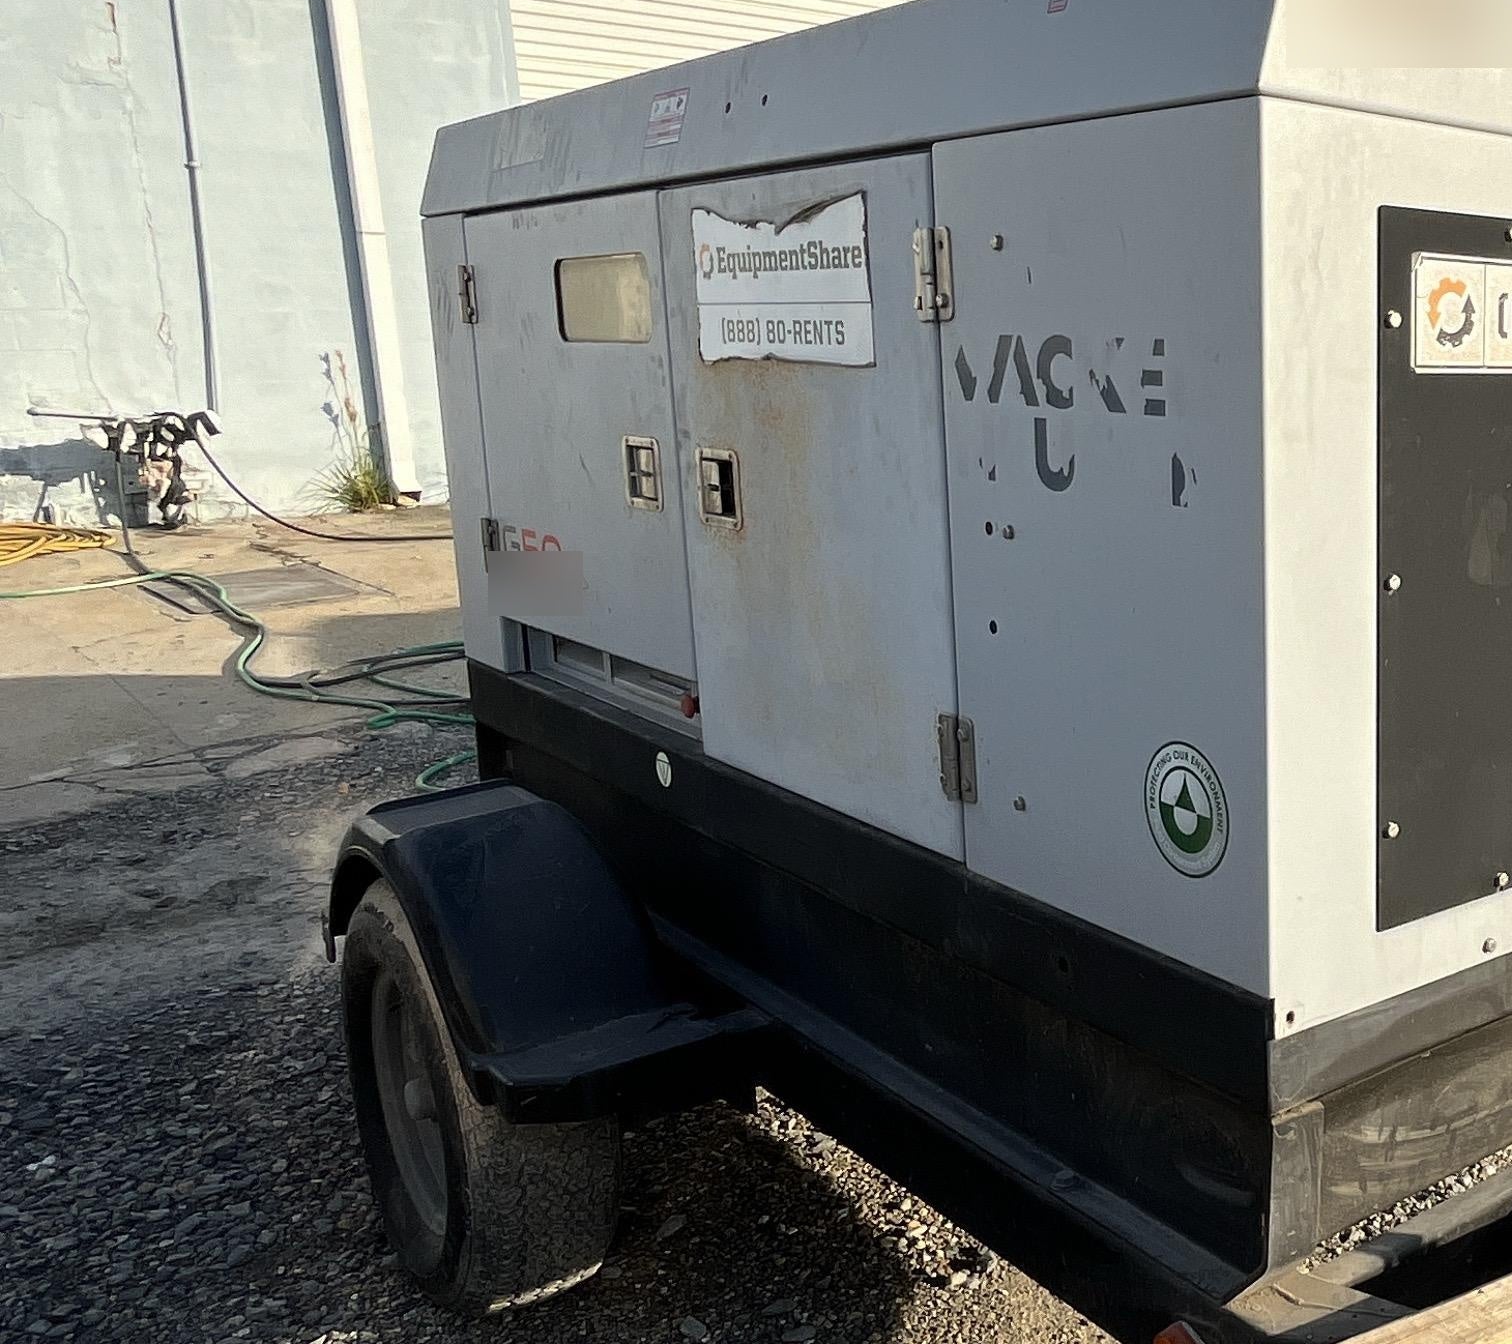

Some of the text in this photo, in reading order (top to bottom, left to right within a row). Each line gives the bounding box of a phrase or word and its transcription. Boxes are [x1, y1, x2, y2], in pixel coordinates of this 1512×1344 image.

[715, 240, 863, 280] EquipmentShare
[721, 317, 846, 346] (888) 80-RENTS
[1149, 750, 1225, 834] PROTECTING OUR ENVIRONMENT
